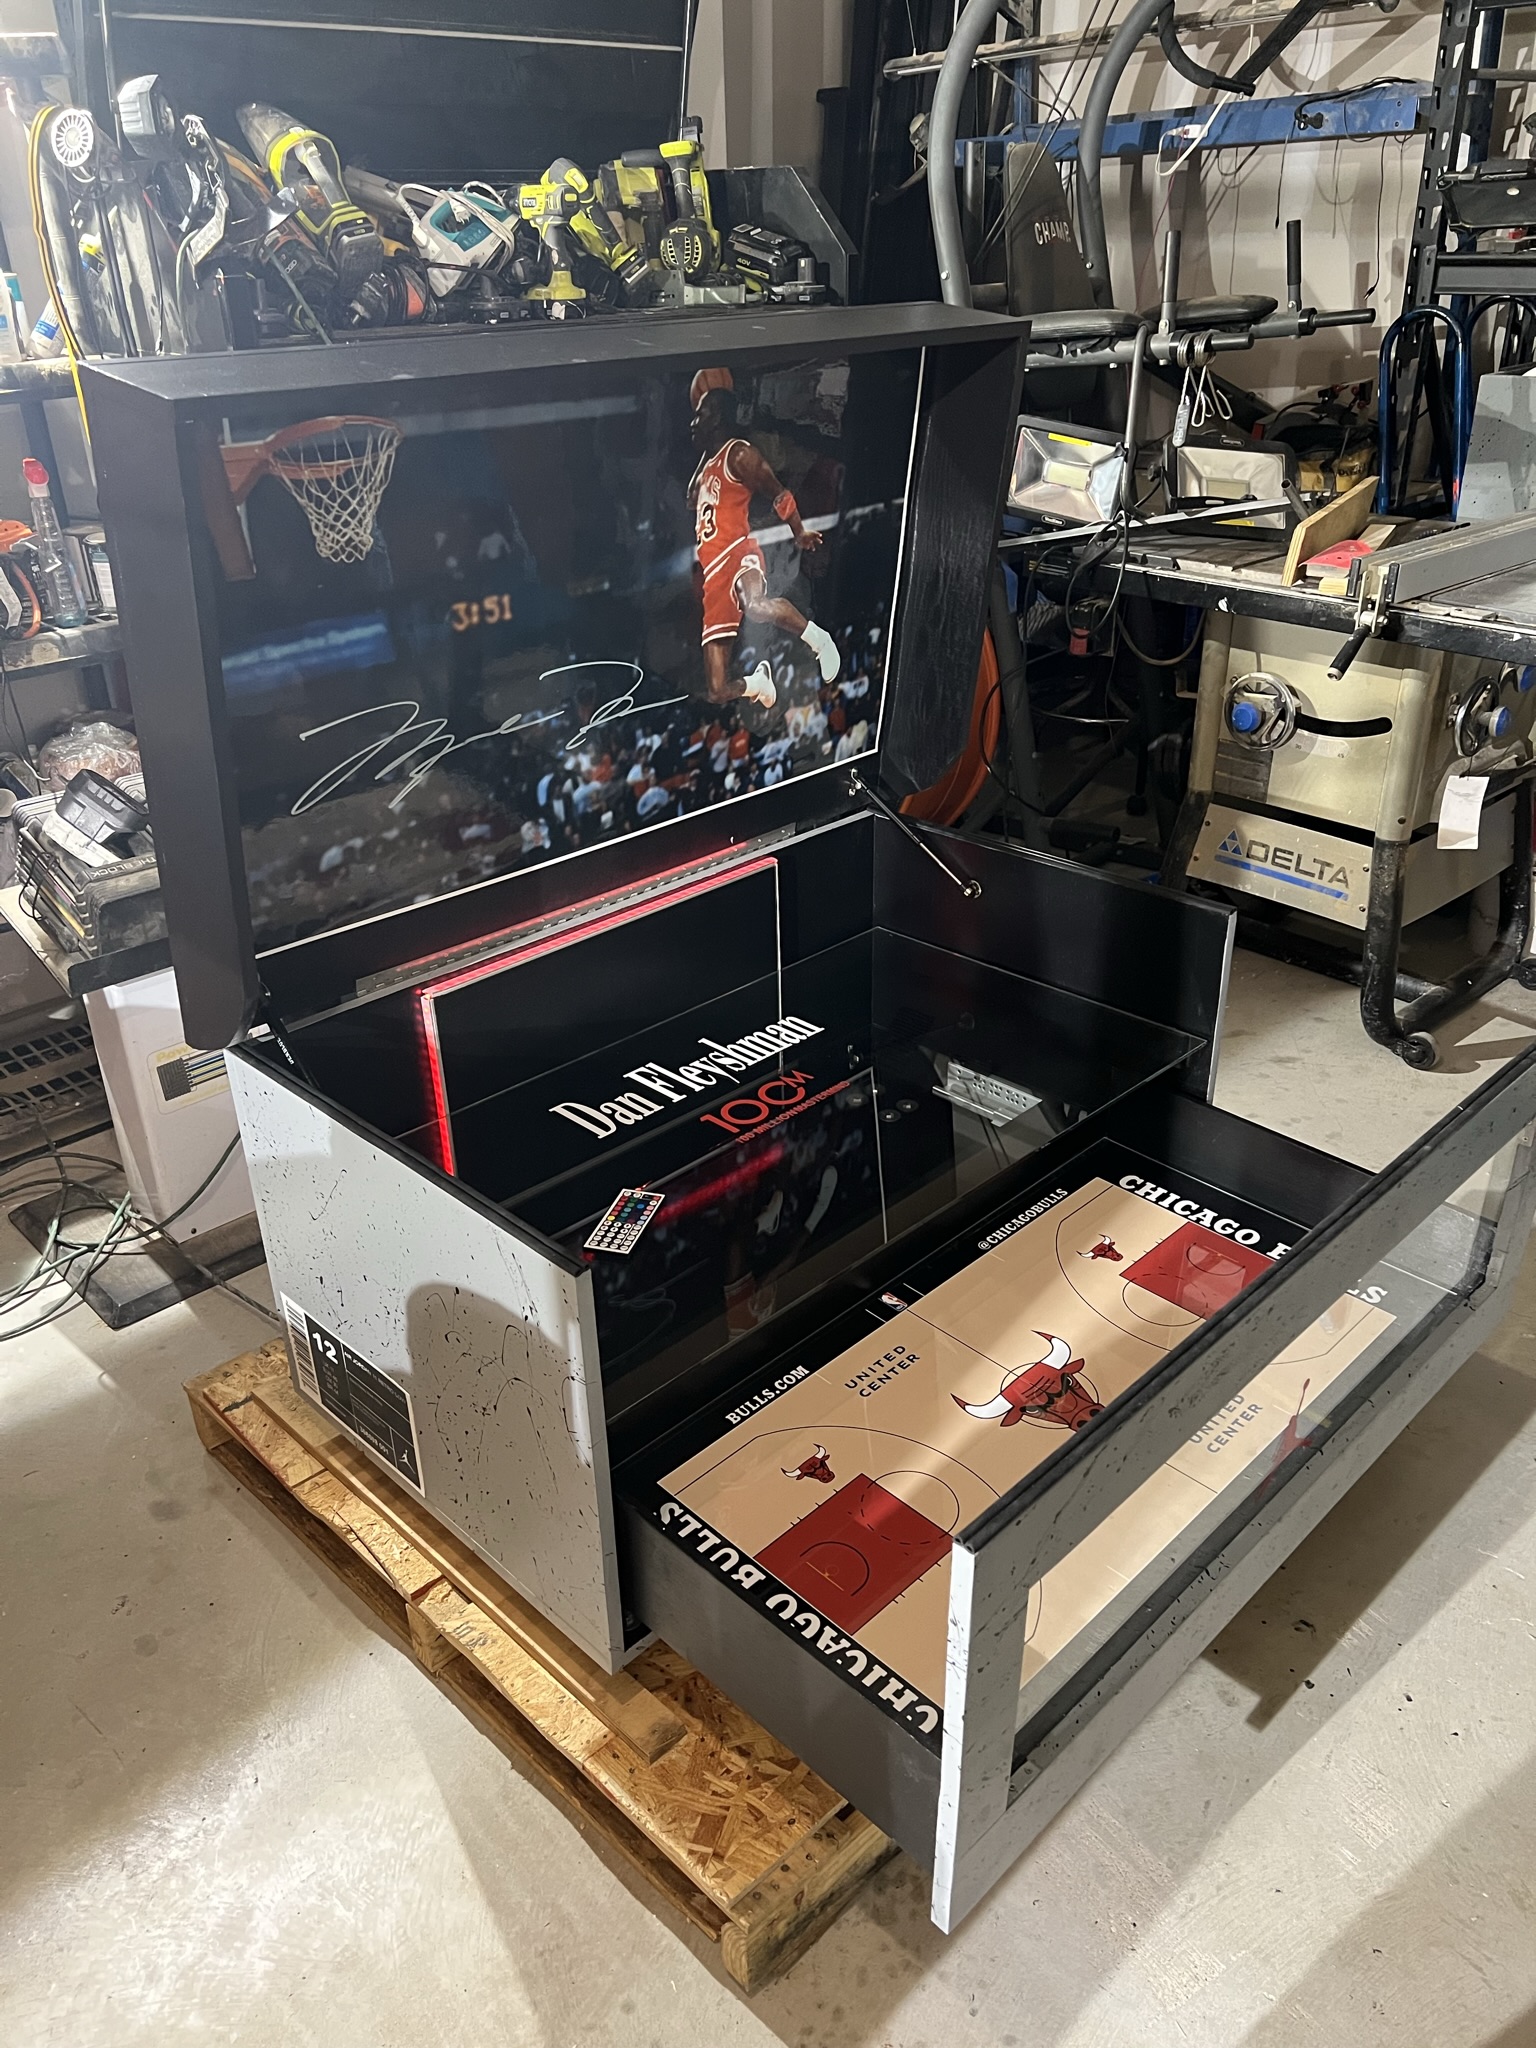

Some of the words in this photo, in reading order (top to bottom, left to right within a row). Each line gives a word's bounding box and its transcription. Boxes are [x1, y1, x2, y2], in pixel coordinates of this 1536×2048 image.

[737, 257, 751, 266] 40V
[452, 594, 513, 631] 3:51
[1246, 839, 1350, 889] DELTA
[549, 1092, 665, 1139] Dan
[623, 1015, 825, 1105] Fleyshman
[977, 1188, 1069, 1250] @CHICAGOBULLS
[1118, 1174, 1261, 1246] CHICAGO
[311, 1332, 339, 1365] 12
[844, 1345, 907, 1392] UNITED
[725, 1365, 811, 1426] BULLS.COM
[858, 1353, 921, 1398] CENTER
[1206, 1403, 1264, 1453] CENTER
[653, 1501, 767, 1591] BULLS
[765, 1592, 940, 1735] CHICAGO
